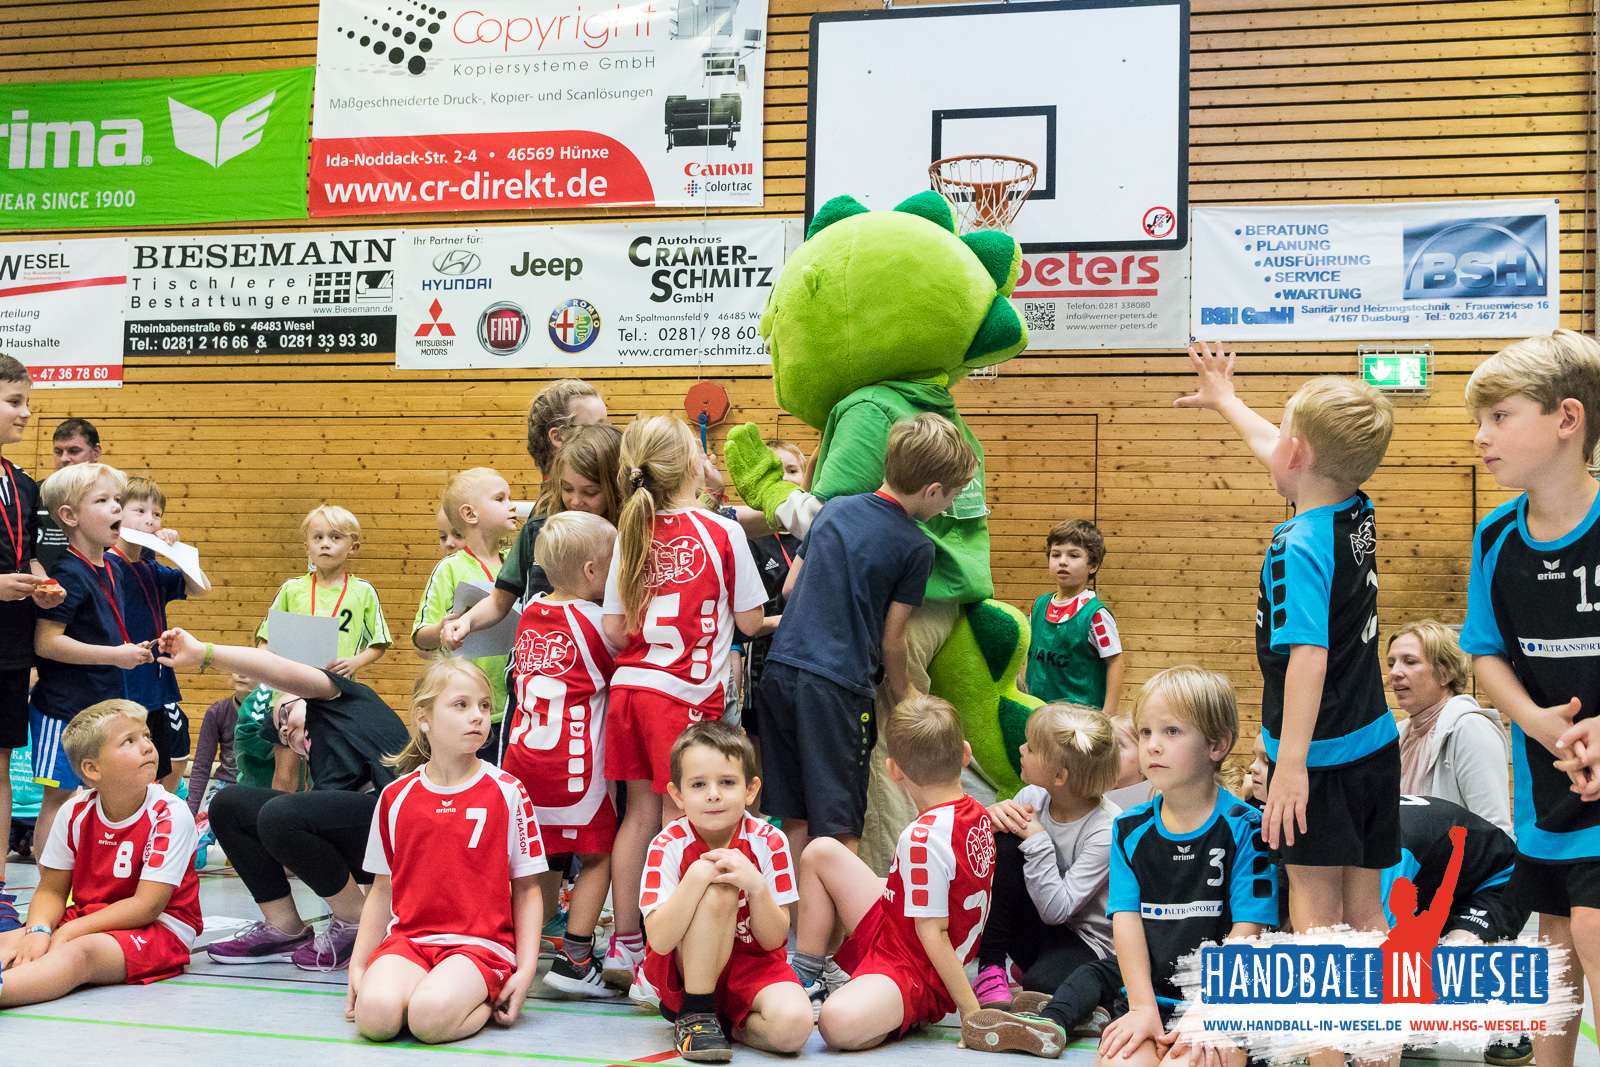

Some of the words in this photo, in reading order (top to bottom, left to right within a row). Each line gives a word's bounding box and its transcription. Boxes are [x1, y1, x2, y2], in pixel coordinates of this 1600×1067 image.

[453, 4, 656, 52] Copyright
[453, 57, 589, 77] Kopiersysteme
[599, 56, 656, 71] GmbH
[329, 94, 439, 110] Maßgeschneiderte
[490, 90, 535, 105] Kopier-
[538, 88, 562, 102] und
[566, 86, 653, 103] Scanlösungen
[325, 151, 448, 168] Ida-Noddack-Str.
[453, 150, 477, 164] 2-4
[506, 147, 555, 162] 46569
[560, 144, 610, 160] Hünxe
[684, 162, 753, 177] Canon
[324, 169, 608, 204] www.cr-direkt.de
[706, 180, 752, 192] Colortrac
[42, 191, 89, 209] SINCE
[96, 189, 135, 208] 1900
[1245, 224, 1329, 237] BERATUNG
[414, 236, 428, 246] Ihr
[429, 235, 463, 246] Partner
[466, 234, 483, 245] für:
[656, 235, 722, 245] Autohaus
[1256, 239, 1331, 252] PLANUNG
[133, 239, 397, 269] BIESEMANN
[628, 236, 758, 267] CRAMER-
[510, 252, 583, 281] Jeep
[1263, 254, 1371, 268] AUSFÜHRUNG
[1274, 270, 1341, 283] SERVICE
[1422, 251, 1527, 290] BSH
[132, 274, 312, 291] Tischlerei
[422, 278, 492, 291] HYUNDAI
[650, 267, 773, 303] SCHMITZ
[131, 293, 308, 309] Bestattungen
[673, 292, 714, 303] GmbH
[1283, 287, 1361, 300] WARTUNG
[312, 304, 393, 314] www.Biesemann.de
[550, 304, 568, 328] ALFA
[573, 299, 600, 328] ROMEO
[1067, 302, 1098, 310] Telefon:
[1301, 303, 1338, 314] Sanitär
[1341, 304, 1360, 313] und
[1363, 303, 1451, 314] Heizungstechnik
[1465, 301, 1534, 311] Frauenwiese
[1537, 301, 1549, 310] 16
[619, 314, 633, 323] Am
[636, 313, 700, 324] Spaltmannsfeld
[703, 313, 709, 321] 9
[718, 312, 747, 321] 46485
[748, 312, 761, 320] We
[1066, 312, 1158, 320] info@werner-peters.de
[1201, 307, 1238, 325] BSH
[1328, 314, 1358, 323] 47167
[1361, 313, 1410, 324] Duisburg
[1425, 312, 1446, 321] Tel.:
[1449, 311, 1495, 321] 0203.467
[1499, 311, 1518, 320] 214
[130, 321, 221, 334] Rheinbabenstraße
[223, 321, 235, 332] 6b
[251, 320, 282, 331] 46483
[283, 319, 315, 331] Wesel
[490, 317, 519, 341] FIAT
[618, 328, 647, 342] Tel.:
[712, 326, 733, 340] 98
[1066, 322, 1158, 331] www.werner-peters.de
[6, 338, 60, 348] Haushalte
[130, 337, 159, 351] Tel.:
[162, 335, 195, 350] 0281
[199, 335, 207, 349] 2
[212, 335, 228, 349] 16
[231, 335, 249, 349] 66
[256, 335, 267, 348] &
[280, 334, 314, 348] 0281
[318, 334, 336, 347] 33
[339, 333, 356, 347] 93
[360, 333, 377, 347] 30
[416, 340, 453, 348] MITSUBISHI
[420, 348, 448, 356] MOTORS
[40, 368, 55, 380] 47
[58, 368, 72, 380] 36
[76, 368, 90, 380] 78
[93, 367, 108, 379] 60
[1537, 571, 1566, 580] erima
[338, 608, 353, 633] 2
[643, 592, 685, 668] 5
[509, 673, 567, 750] 10
[465, 807, 487, 848] 7
[516, 818, 528, 855] PLASSON
[113, 840, 134, 878] 8
[1207, 847, 1226, 887] 3
